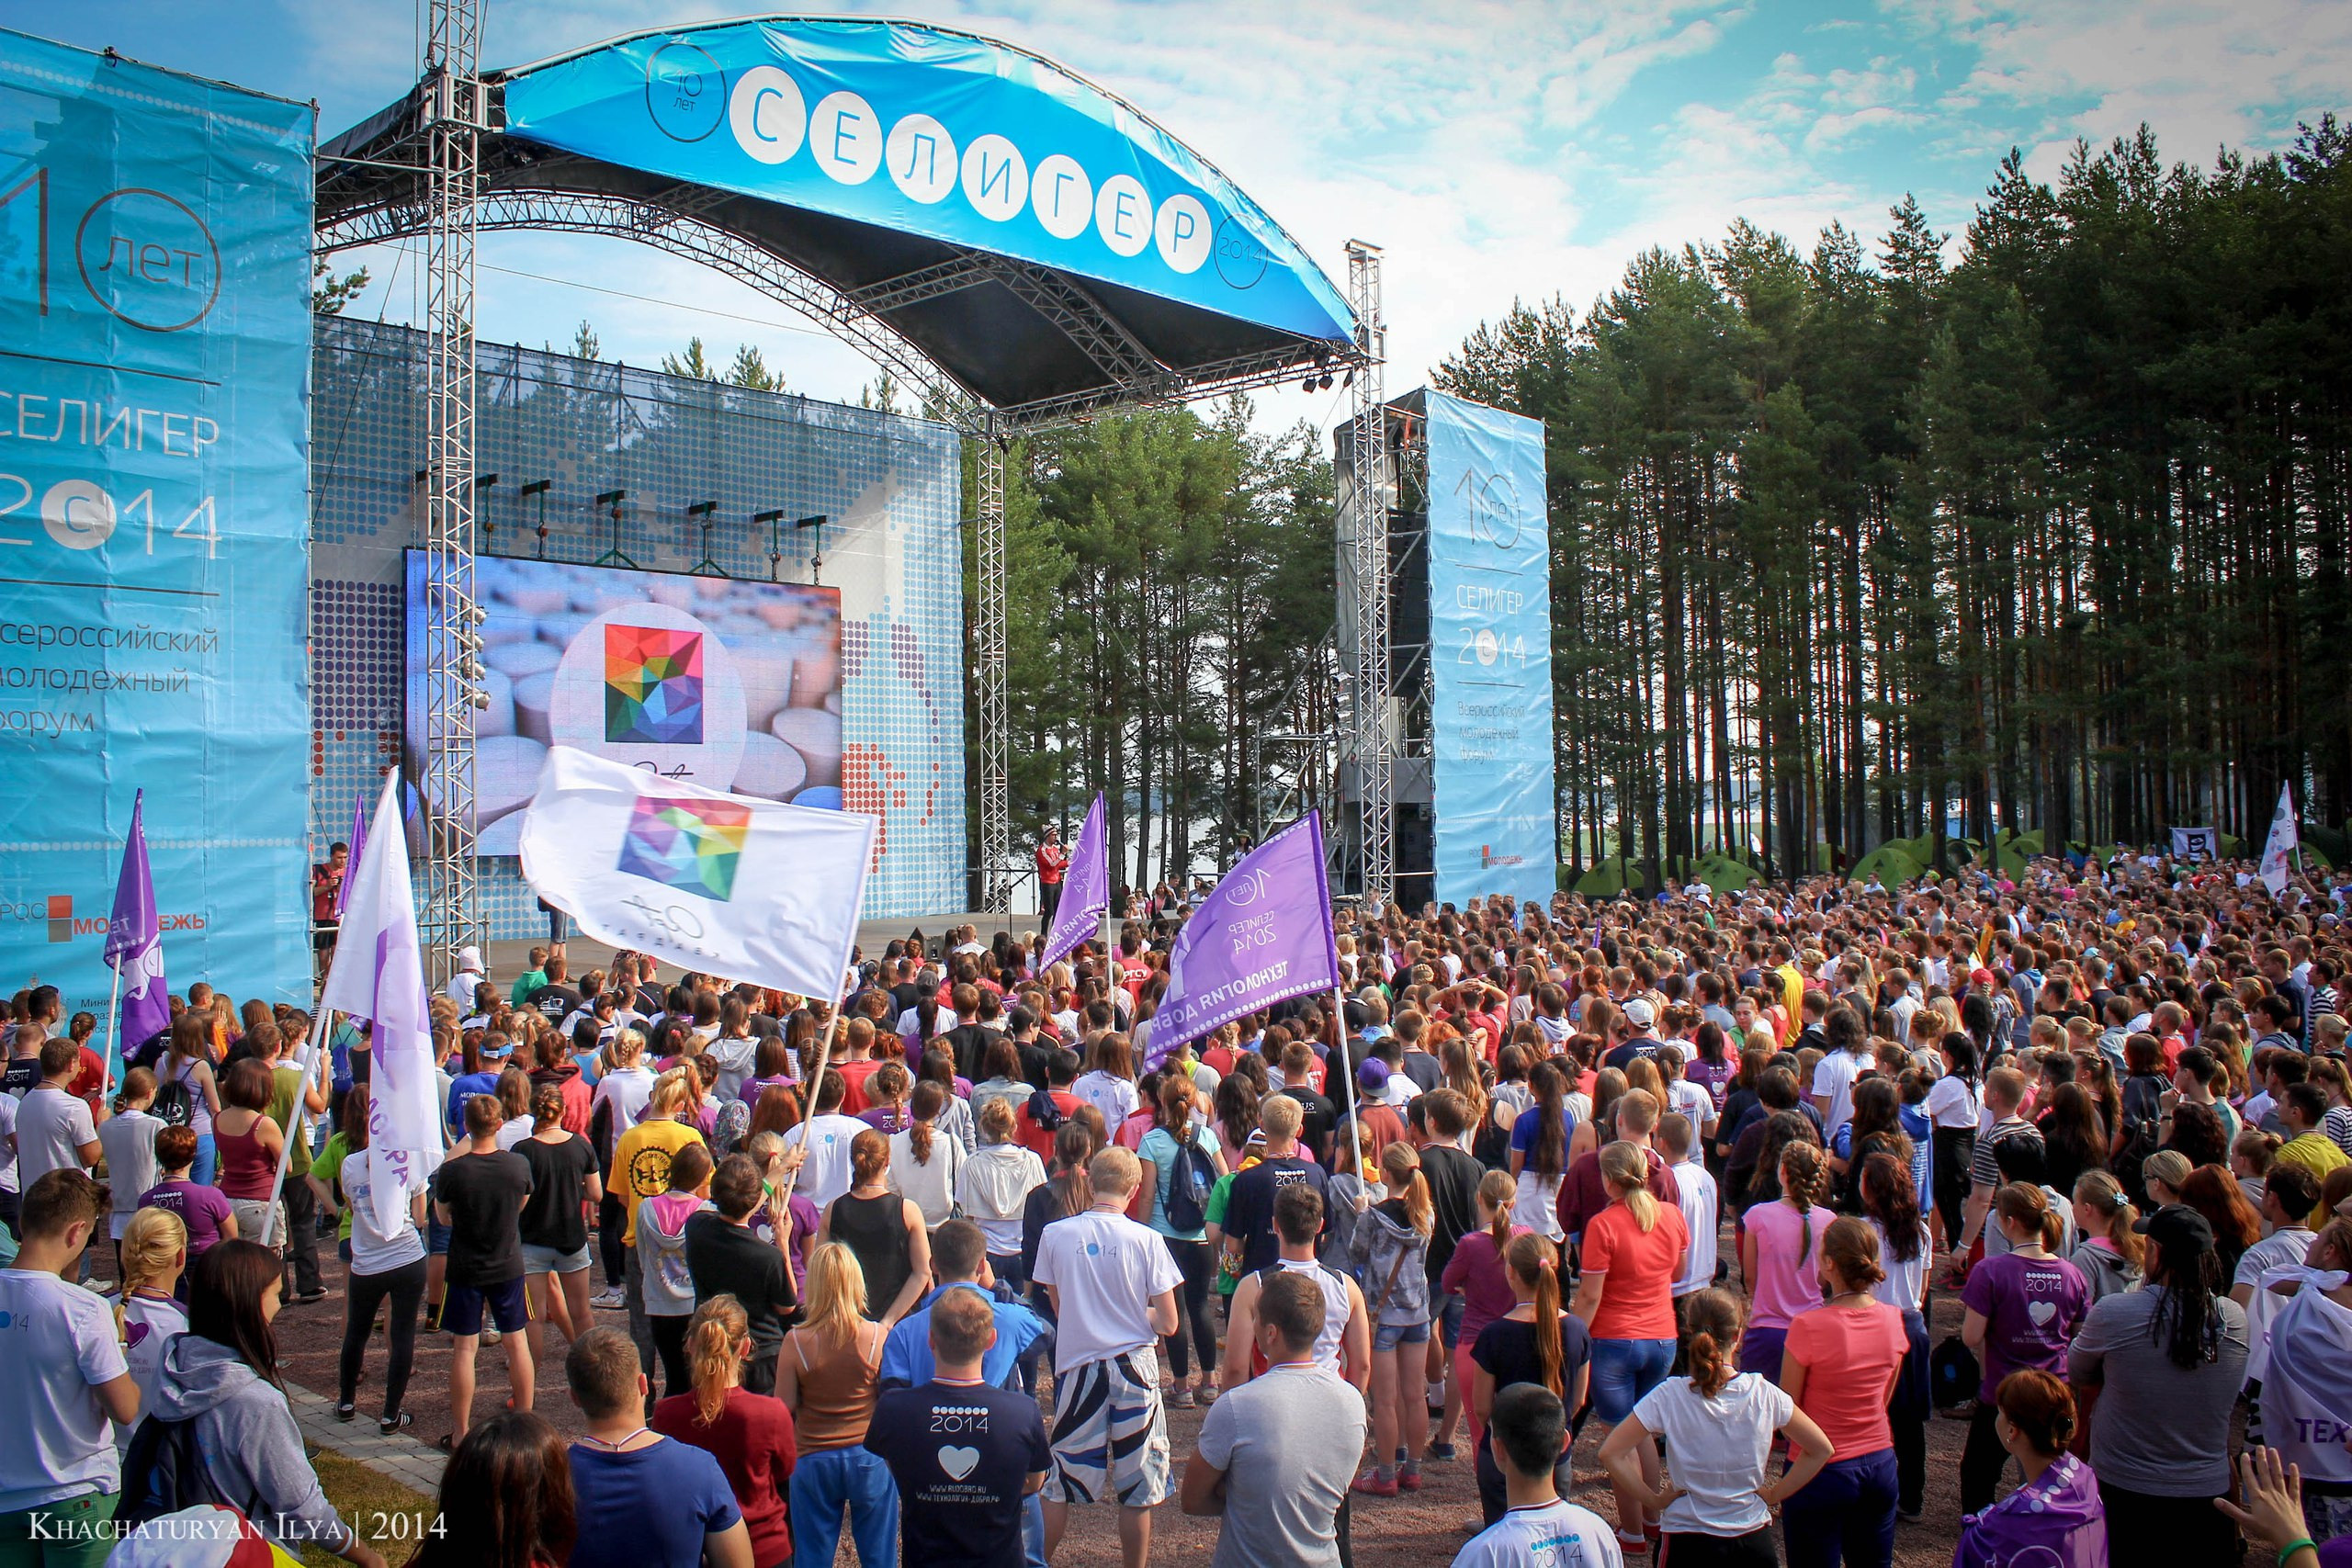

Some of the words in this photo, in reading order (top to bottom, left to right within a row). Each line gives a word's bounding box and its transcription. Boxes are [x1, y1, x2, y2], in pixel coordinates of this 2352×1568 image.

[675, 69, 702, 96] 10
[673, 96, 695, 112] лет
[753, 87, 1194, 253] СЕЛИГЕР
[1219, 237, 1262, 265] 2014
[99, 236, 202, 288] лет
[1487, 501, 1516, 525] лет
[1456, 584, 1523, 615] СЕЛИГЕР
[0, 667, 189, 694] олодежный
[6, 1072, 29, 1082] 2014
[2025, 1279, 2062, 1292] 2014
[930, 1415, 989, 1433] 2014
